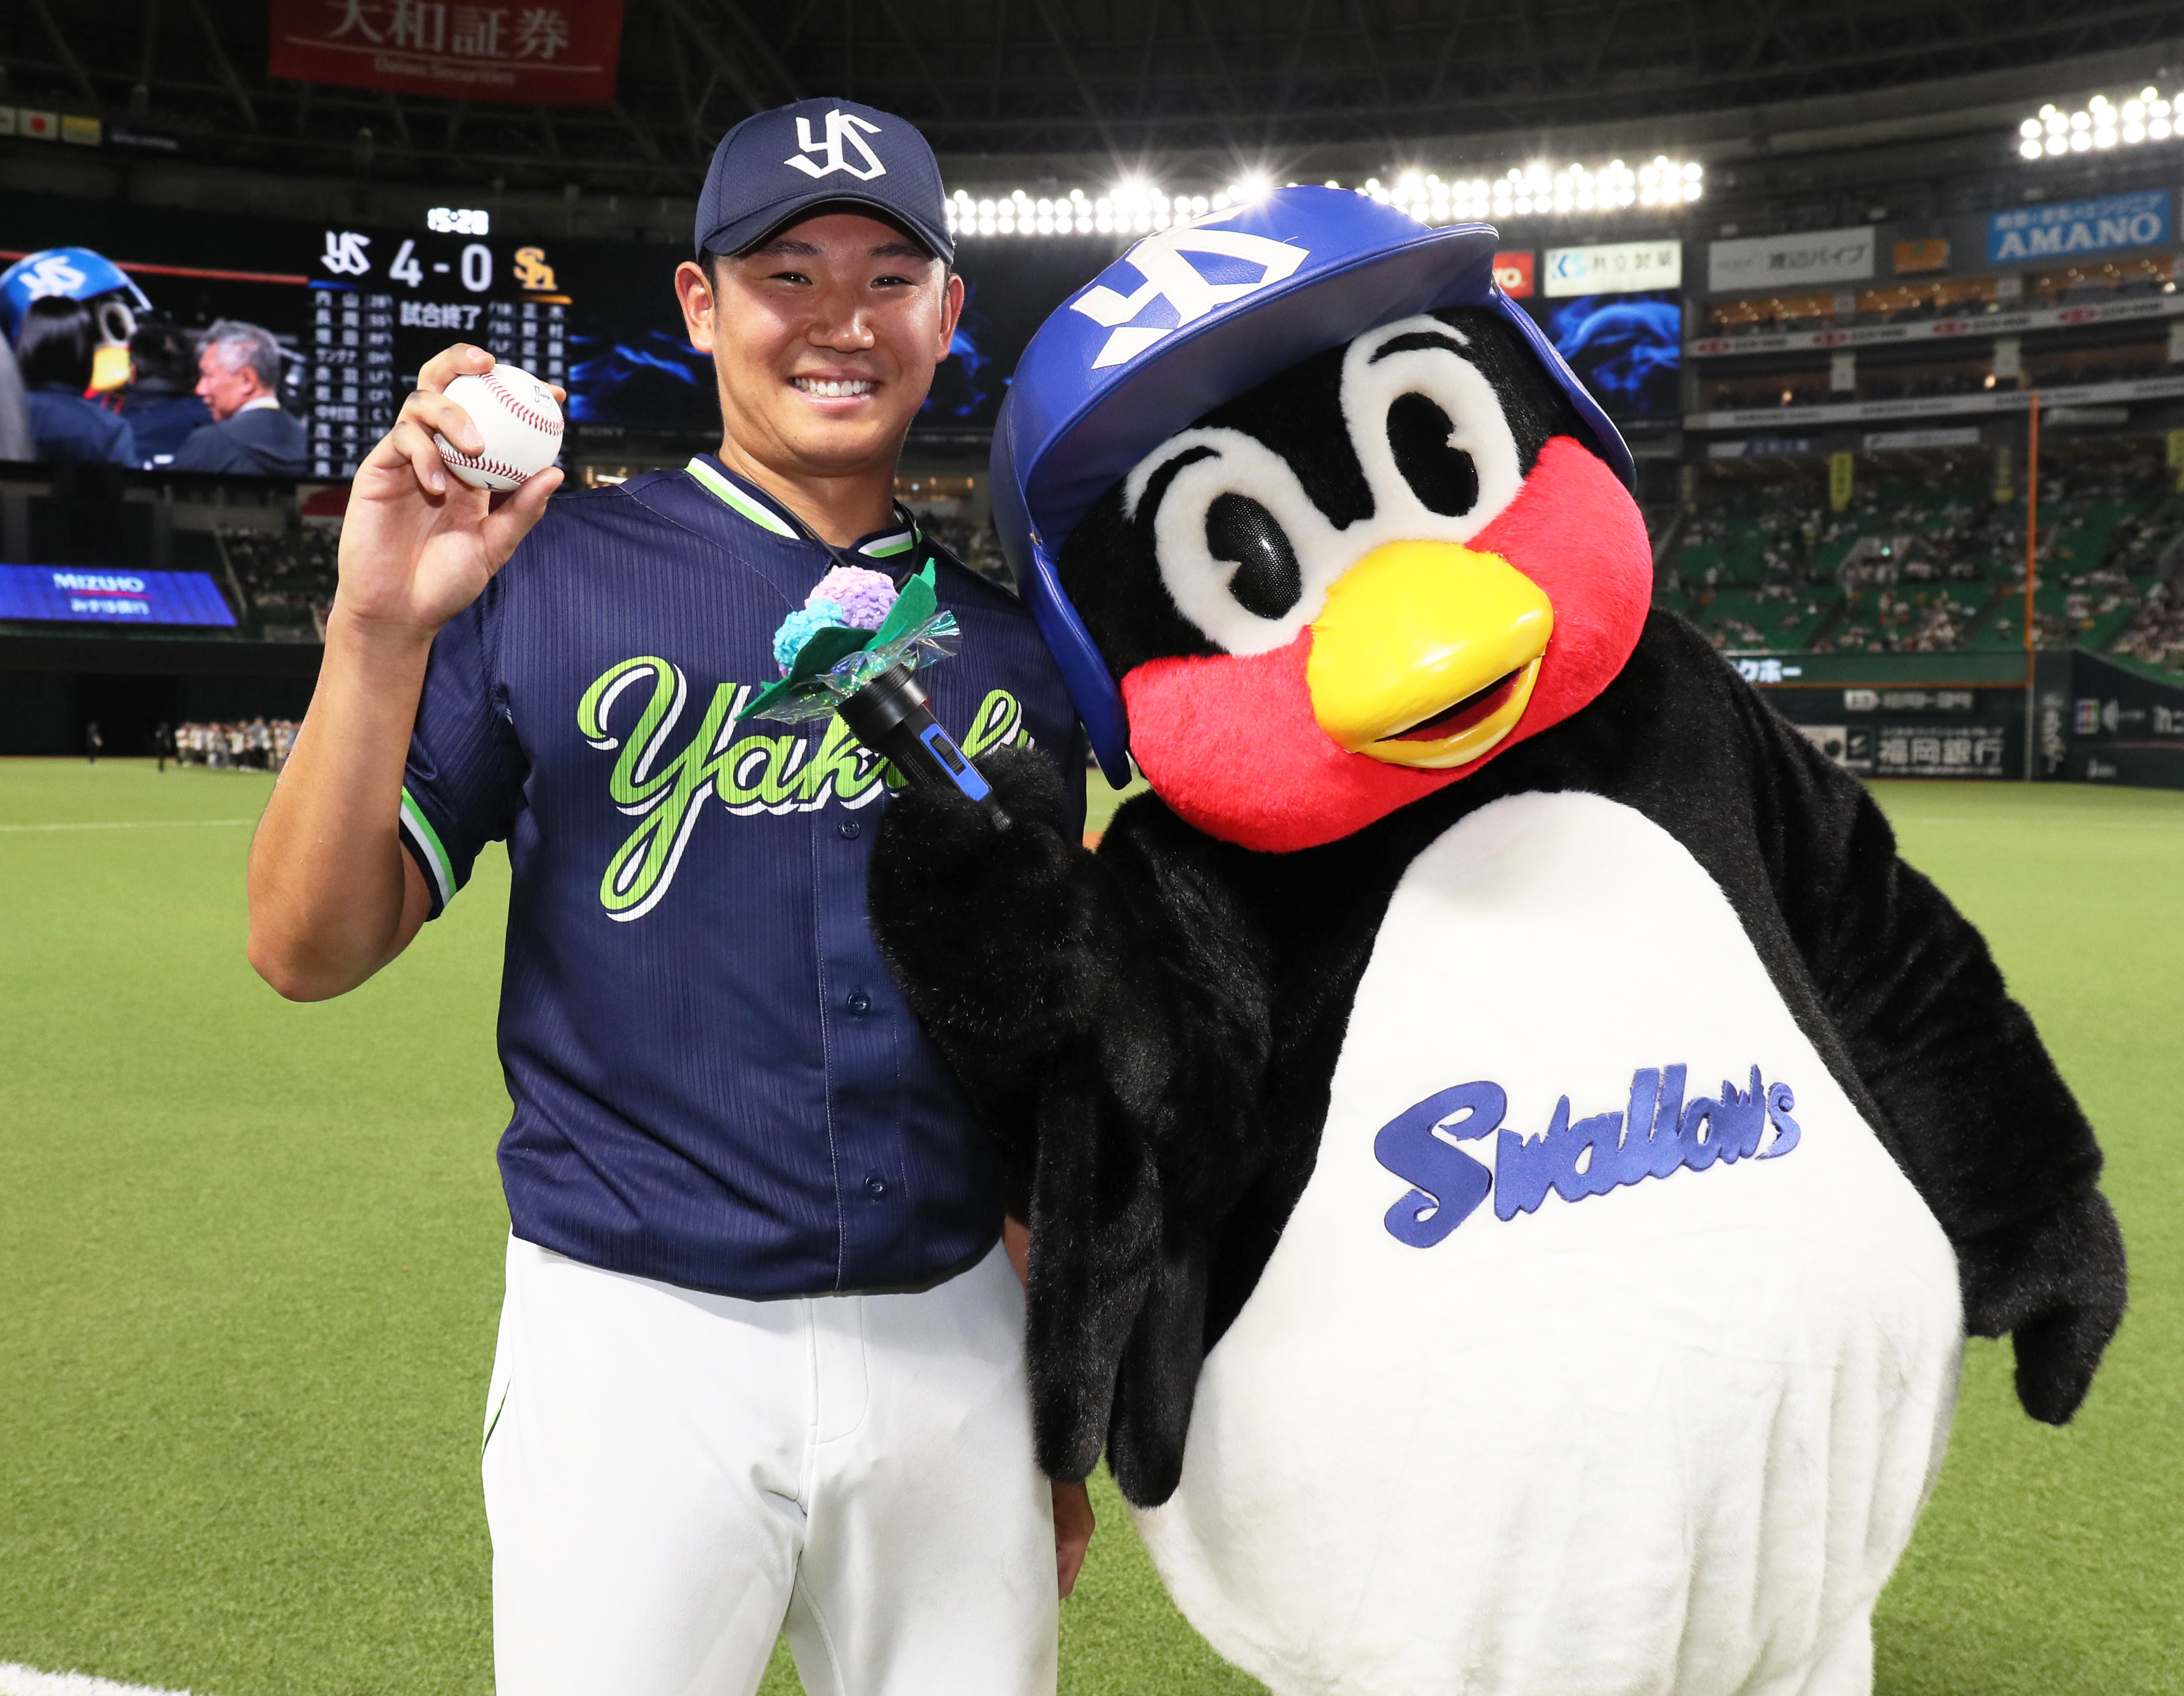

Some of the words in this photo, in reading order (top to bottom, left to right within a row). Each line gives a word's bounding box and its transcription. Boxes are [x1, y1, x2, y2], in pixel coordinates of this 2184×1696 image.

[327, 0, 569, 59] 大和証券
[1996, 212, 2162, 261] AMANO
[389, 239, 424, 288] 4
[461, 244, 492, 292] 0
[400, 300, 482, 330] 試合終了
[1878, 737, 2004, 766] 福岡銀行
[1373, 1063, 1801, 1249] Swallows
